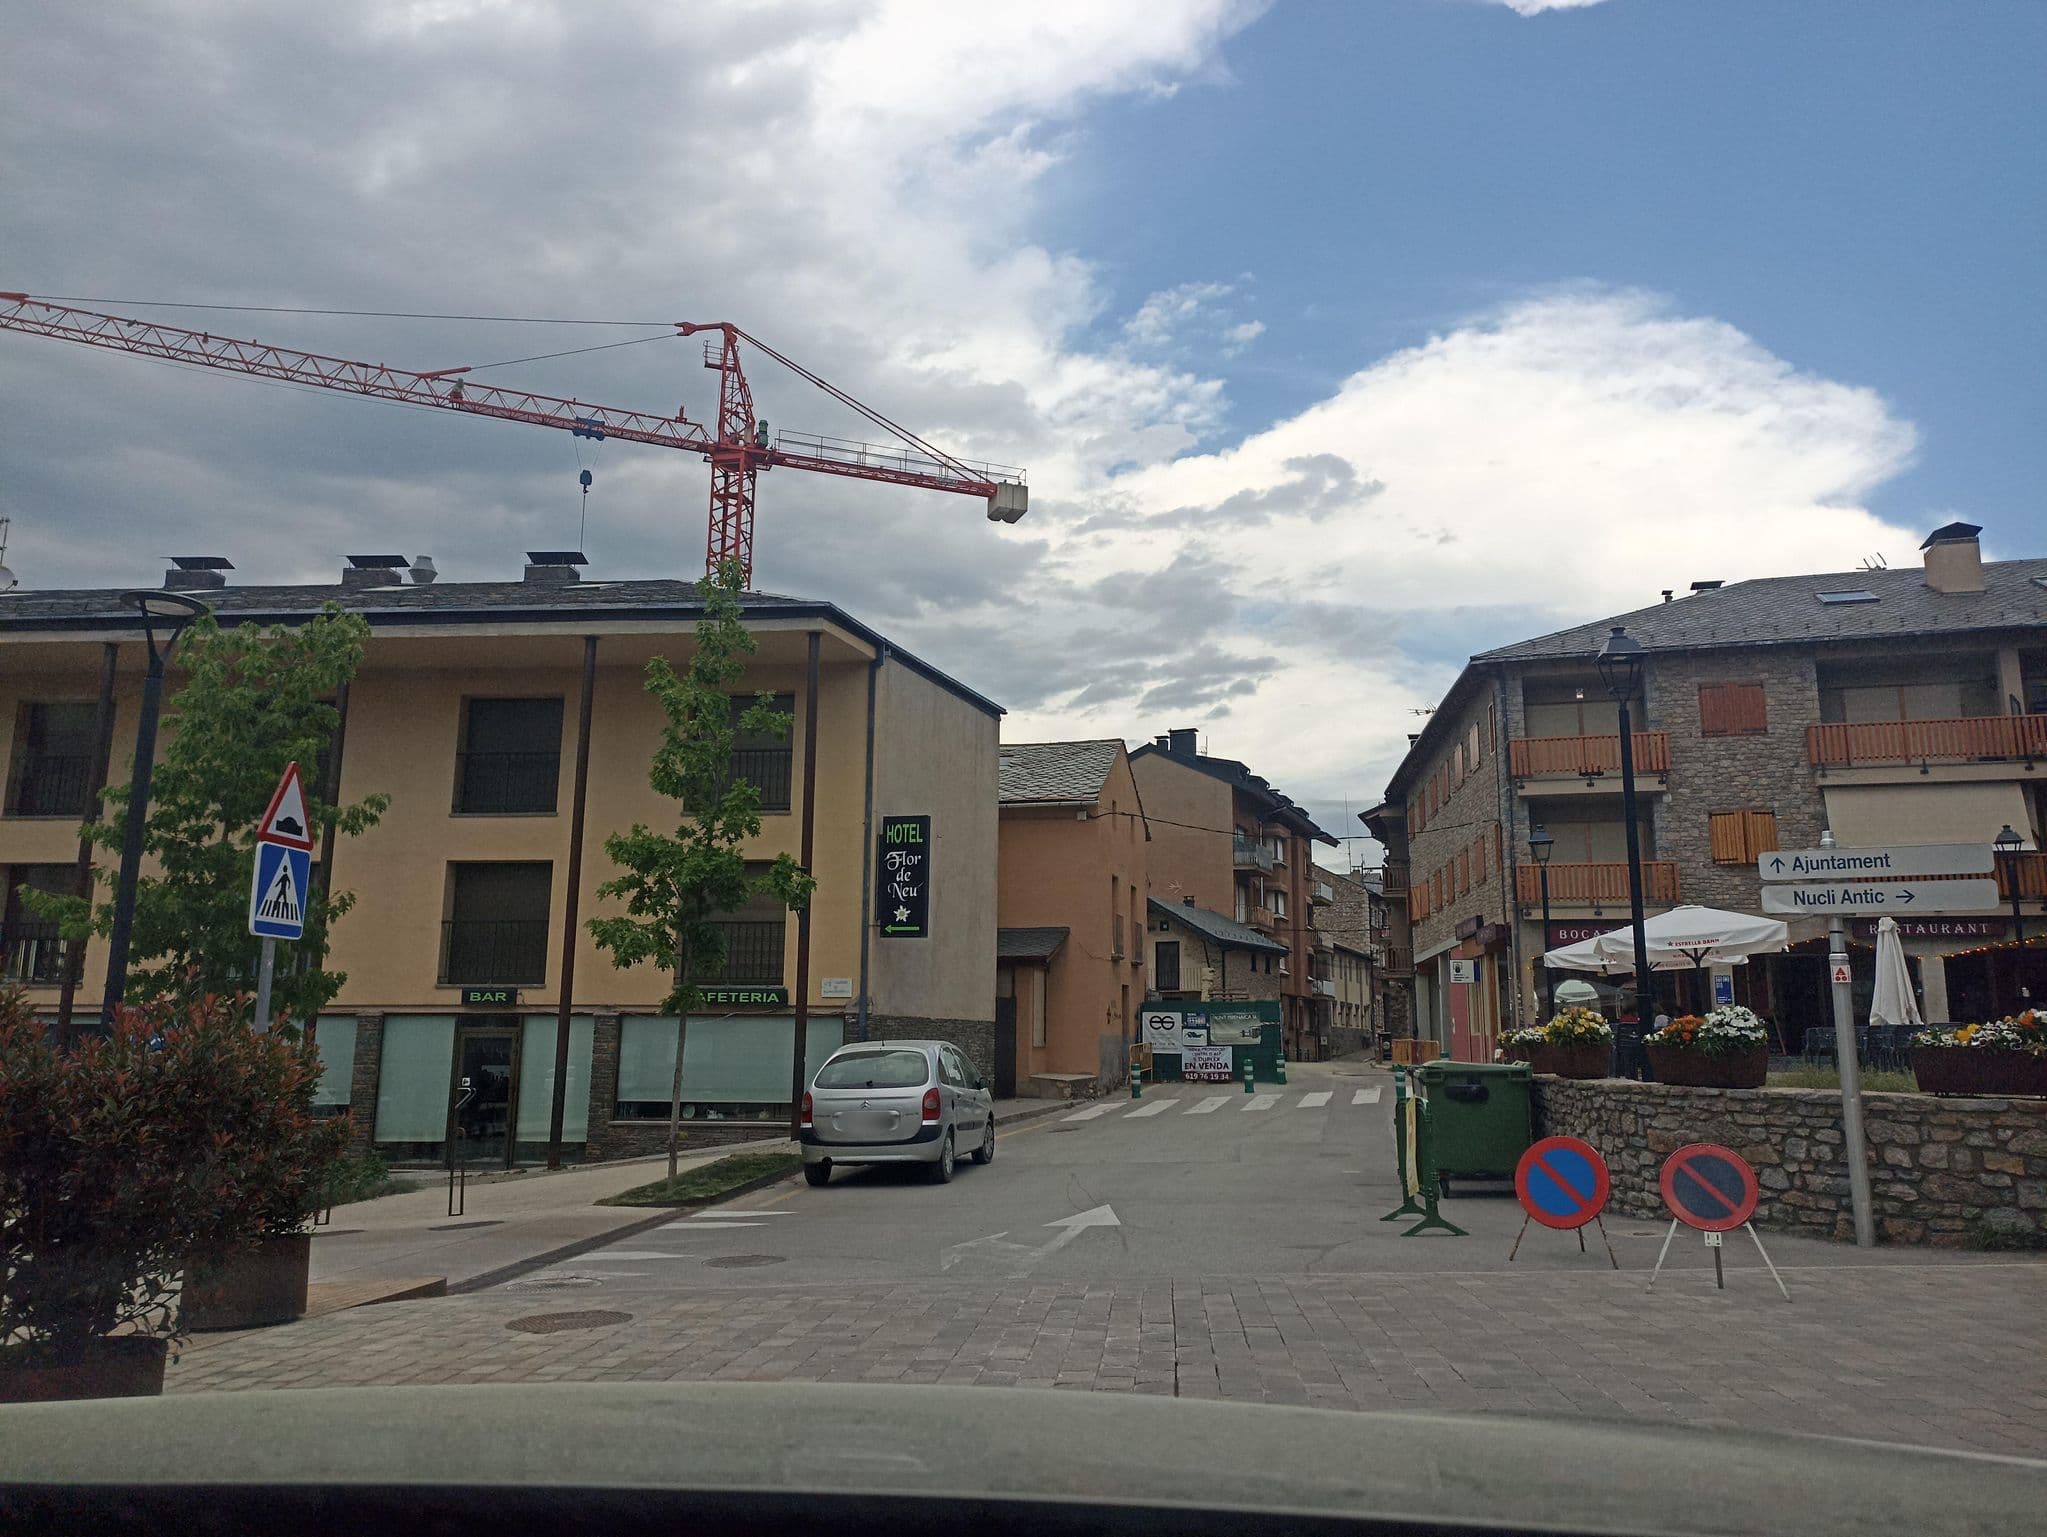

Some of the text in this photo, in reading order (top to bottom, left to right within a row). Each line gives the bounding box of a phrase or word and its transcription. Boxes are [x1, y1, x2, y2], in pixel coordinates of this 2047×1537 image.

[886, 823, 924, 844] HOTEL
[884, 850, 922, 871] Flor
[1792, 853, 1892, 874] Ajuntament
[896, 866, 912, 882] de
[887, 881, 924, 902] Neu
[1793, 888, 1885, 906] Nucli Antic
[1674, 939, 1701, 948] ESTRELLA
[469, 992, 508, 1002] BAR
[1184, 1062, 1230, 1070] EN VENDA
[1185, 1072, 1199, 1080] 619
[1200, 1072, 1209, 1080] 76
[1210, 1072, 1219, 1080] 19
